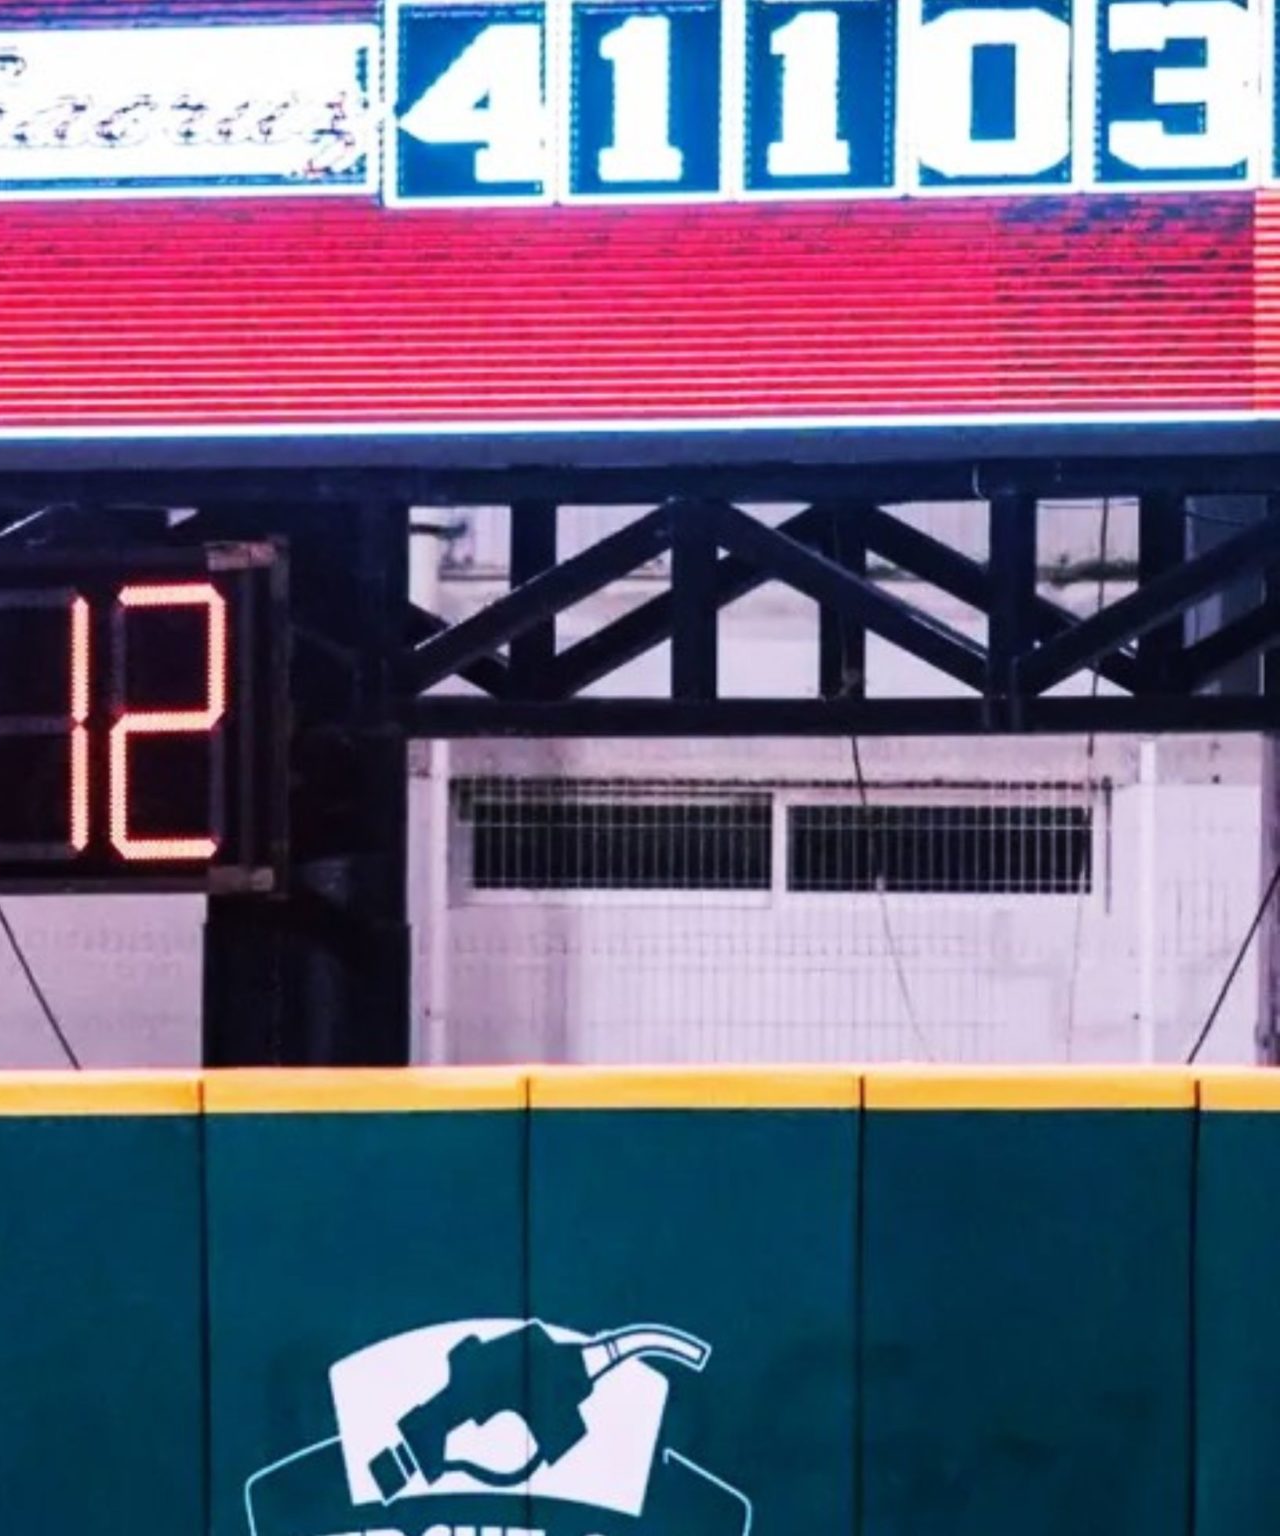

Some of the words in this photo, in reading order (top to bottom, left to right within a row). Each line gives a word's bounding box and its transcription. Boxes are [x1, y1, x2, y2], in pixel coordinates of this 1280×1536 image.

[397, 24, 542, 183] 4
[598, 16, 682, 181] 1
[770, 11, 851, 176] 1
[919, 7, 1072, 178] 0
[1108, 0, 1248, 171] 3
